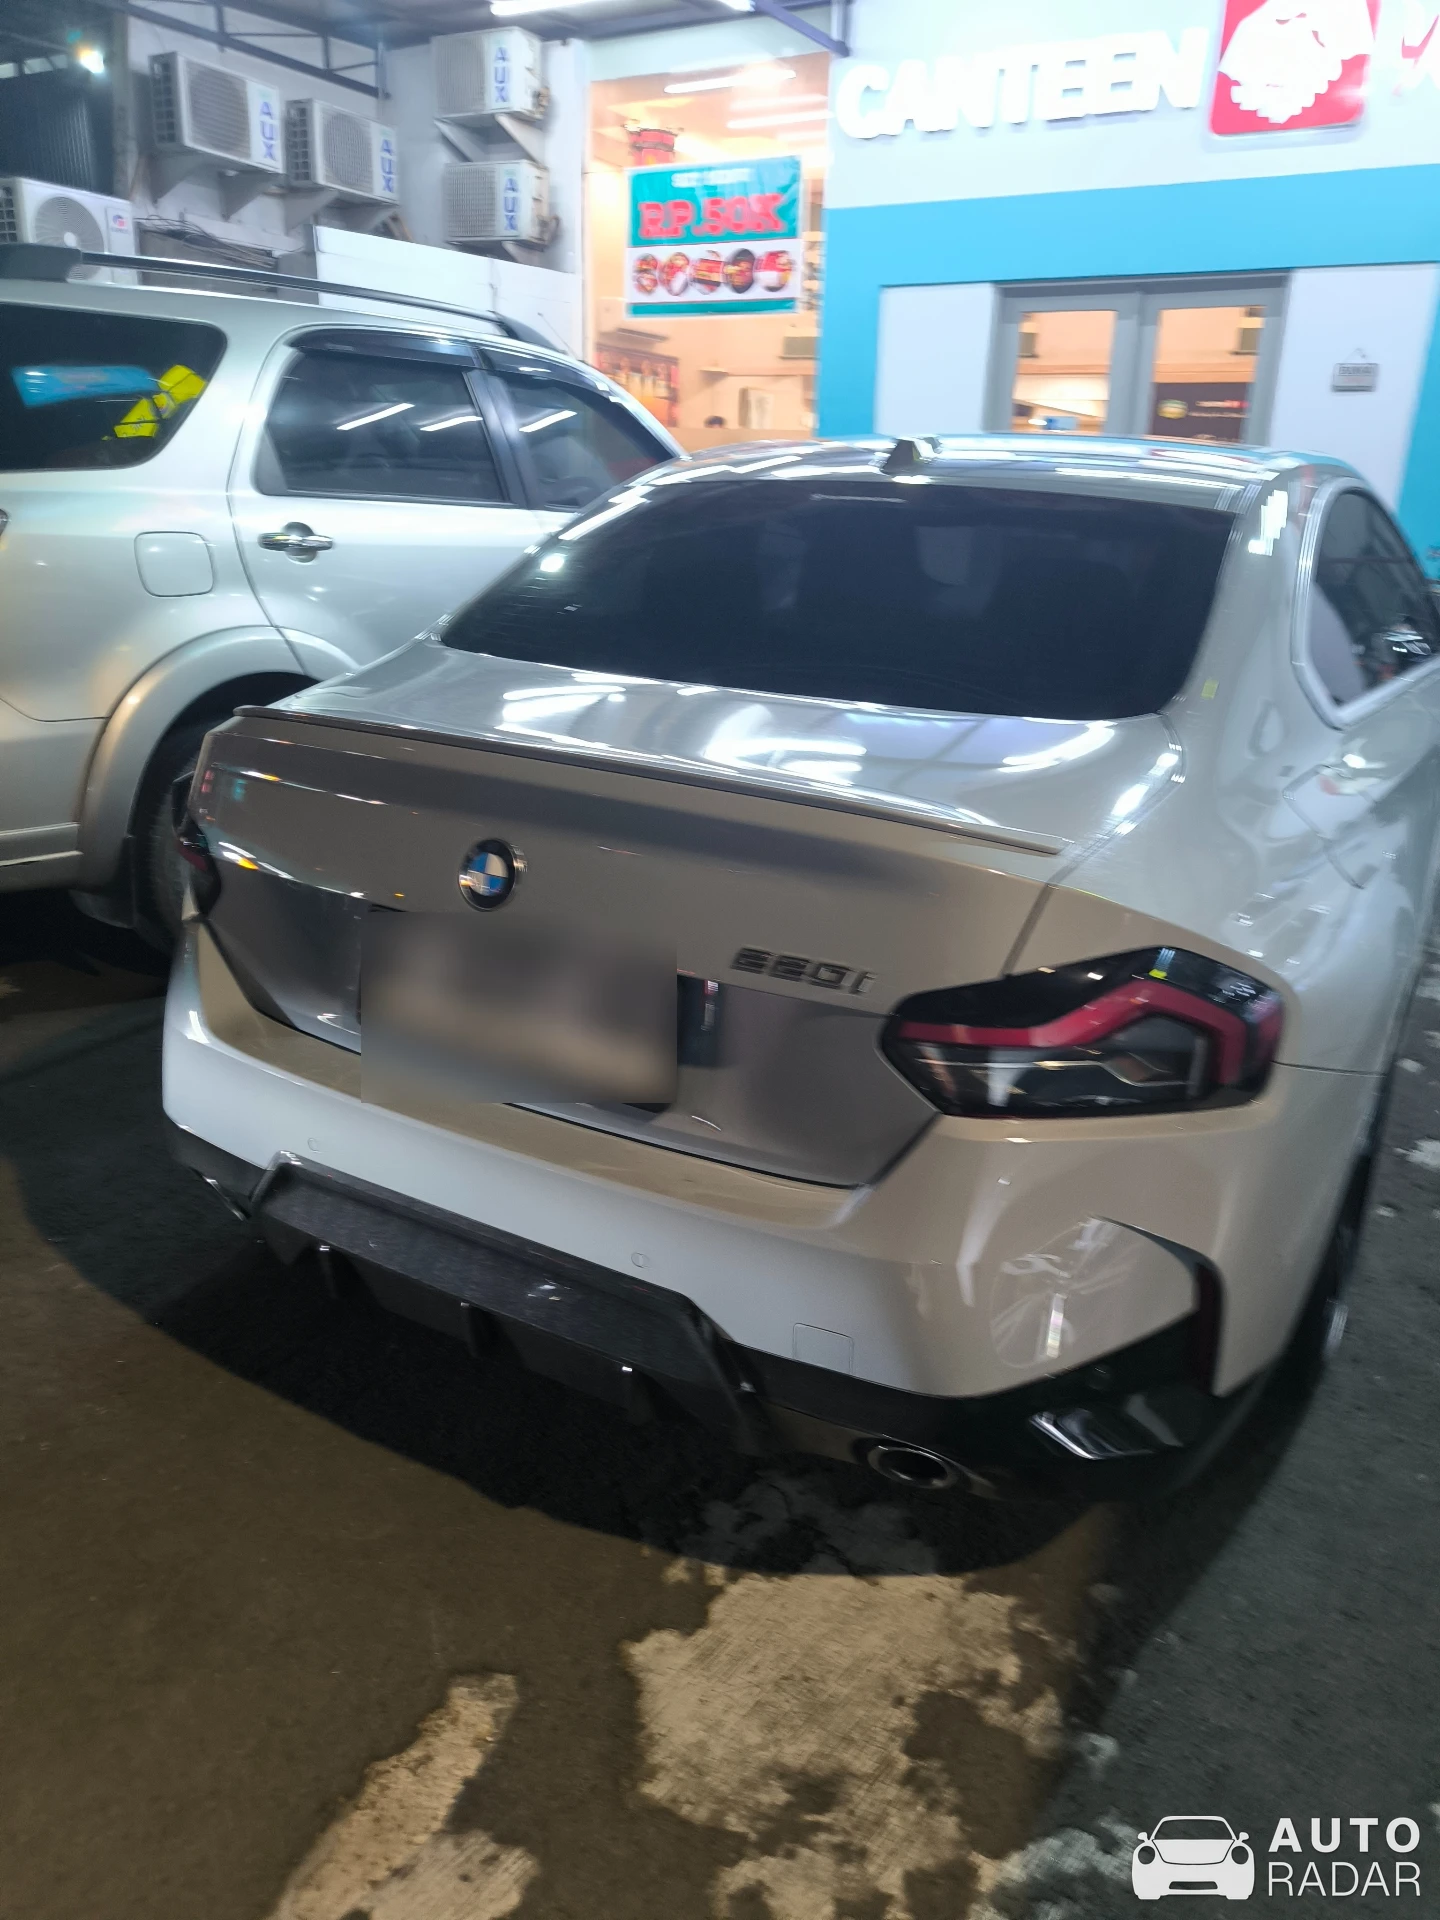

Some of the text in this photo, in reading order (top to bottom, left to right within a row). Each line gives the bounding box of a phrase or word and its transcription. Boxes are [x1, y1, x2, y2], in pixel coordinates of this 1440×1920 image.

[494, 46, 510, 103] AUX
[836, 28, 1208, 139] CANTEEN
[259, 101, 277, 161] AUX
[380, 139, 395, 193] AUX
[504, 177, 519, 231] AUX
